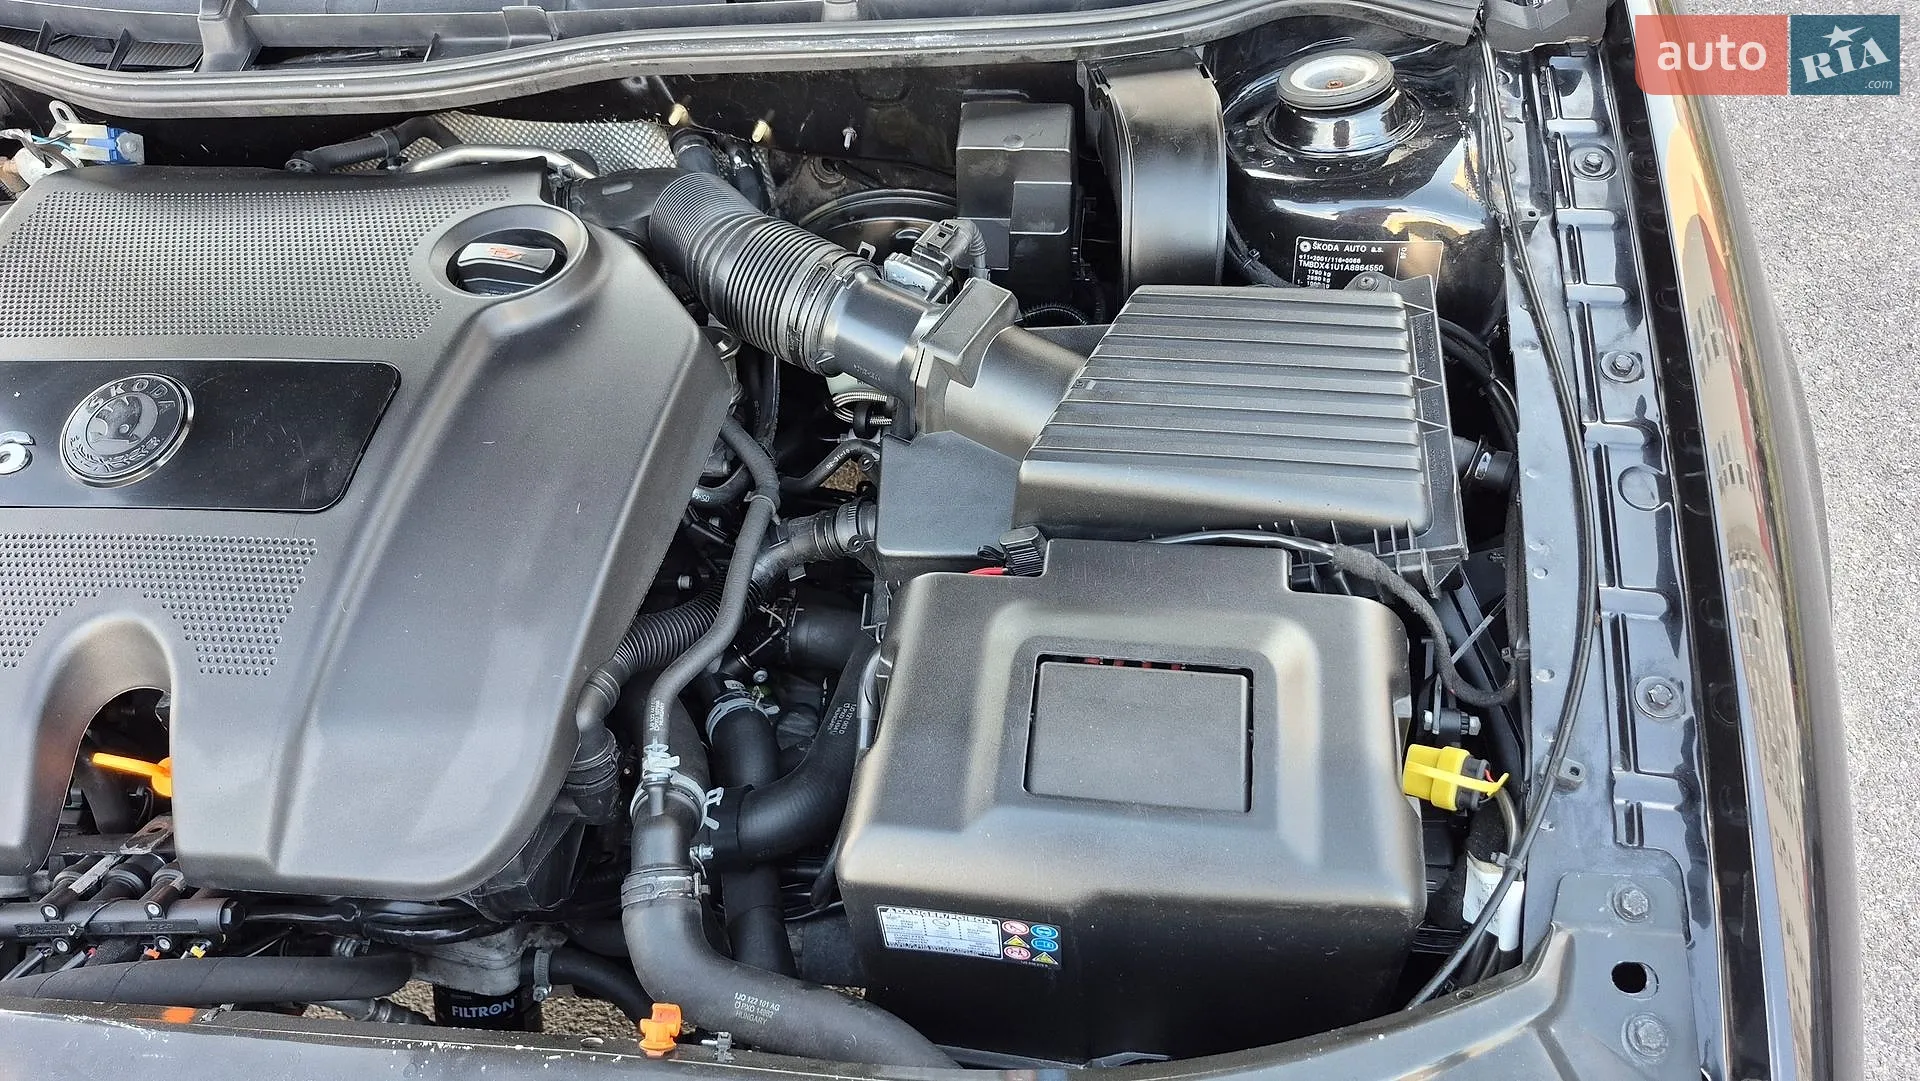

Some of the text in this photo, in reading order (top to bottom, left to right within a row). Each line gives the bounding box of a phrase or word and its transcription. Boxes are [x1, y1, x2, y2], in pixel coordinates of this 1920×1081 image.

[1312, 241, 1340, 252] ŠKODA
[1344, 245, 1367, 253] AUTO
[451, 998, 515, 1018] FILTRON
[747, 995, 759, 1006] 122
[759, 999, 770, 1008] 101
[769, 1002, 781, 1011] AG
[735, 1009, 768, 1025] HUNGARY
